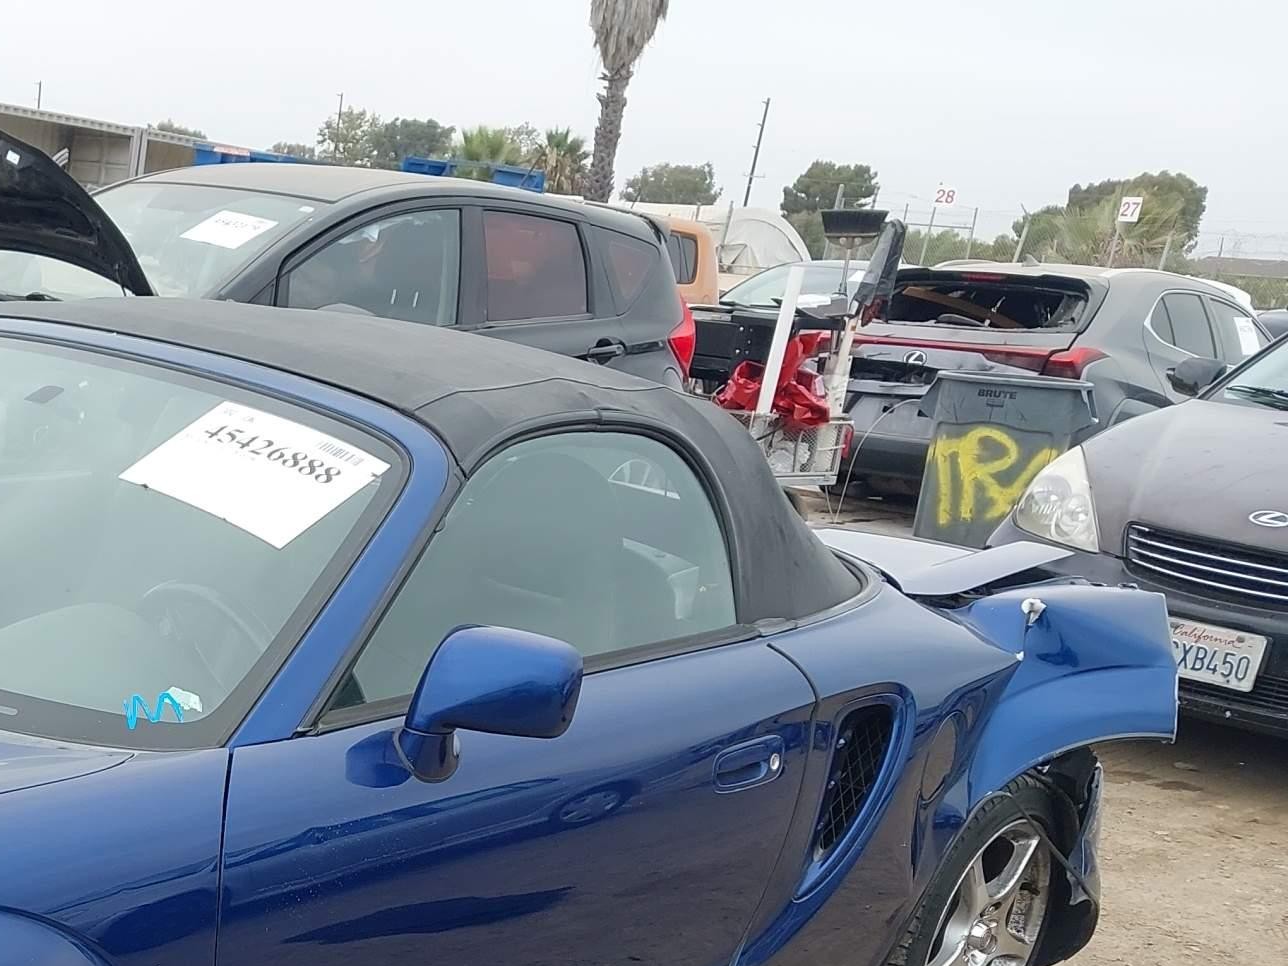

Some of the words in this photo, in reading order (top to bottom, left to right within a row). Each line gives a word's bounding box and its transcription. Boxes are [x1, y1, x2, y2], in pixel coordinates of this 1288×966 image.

[934, 188, 956, 204] 28
[1119, 201, 1141, 217] 27
[977, 388, 1018, 400] BRUTE
[203, 425, 342, 484] 45426888
[1172, 622, 1242, 649] California
[1173, 641, 1251, 682] XB450
